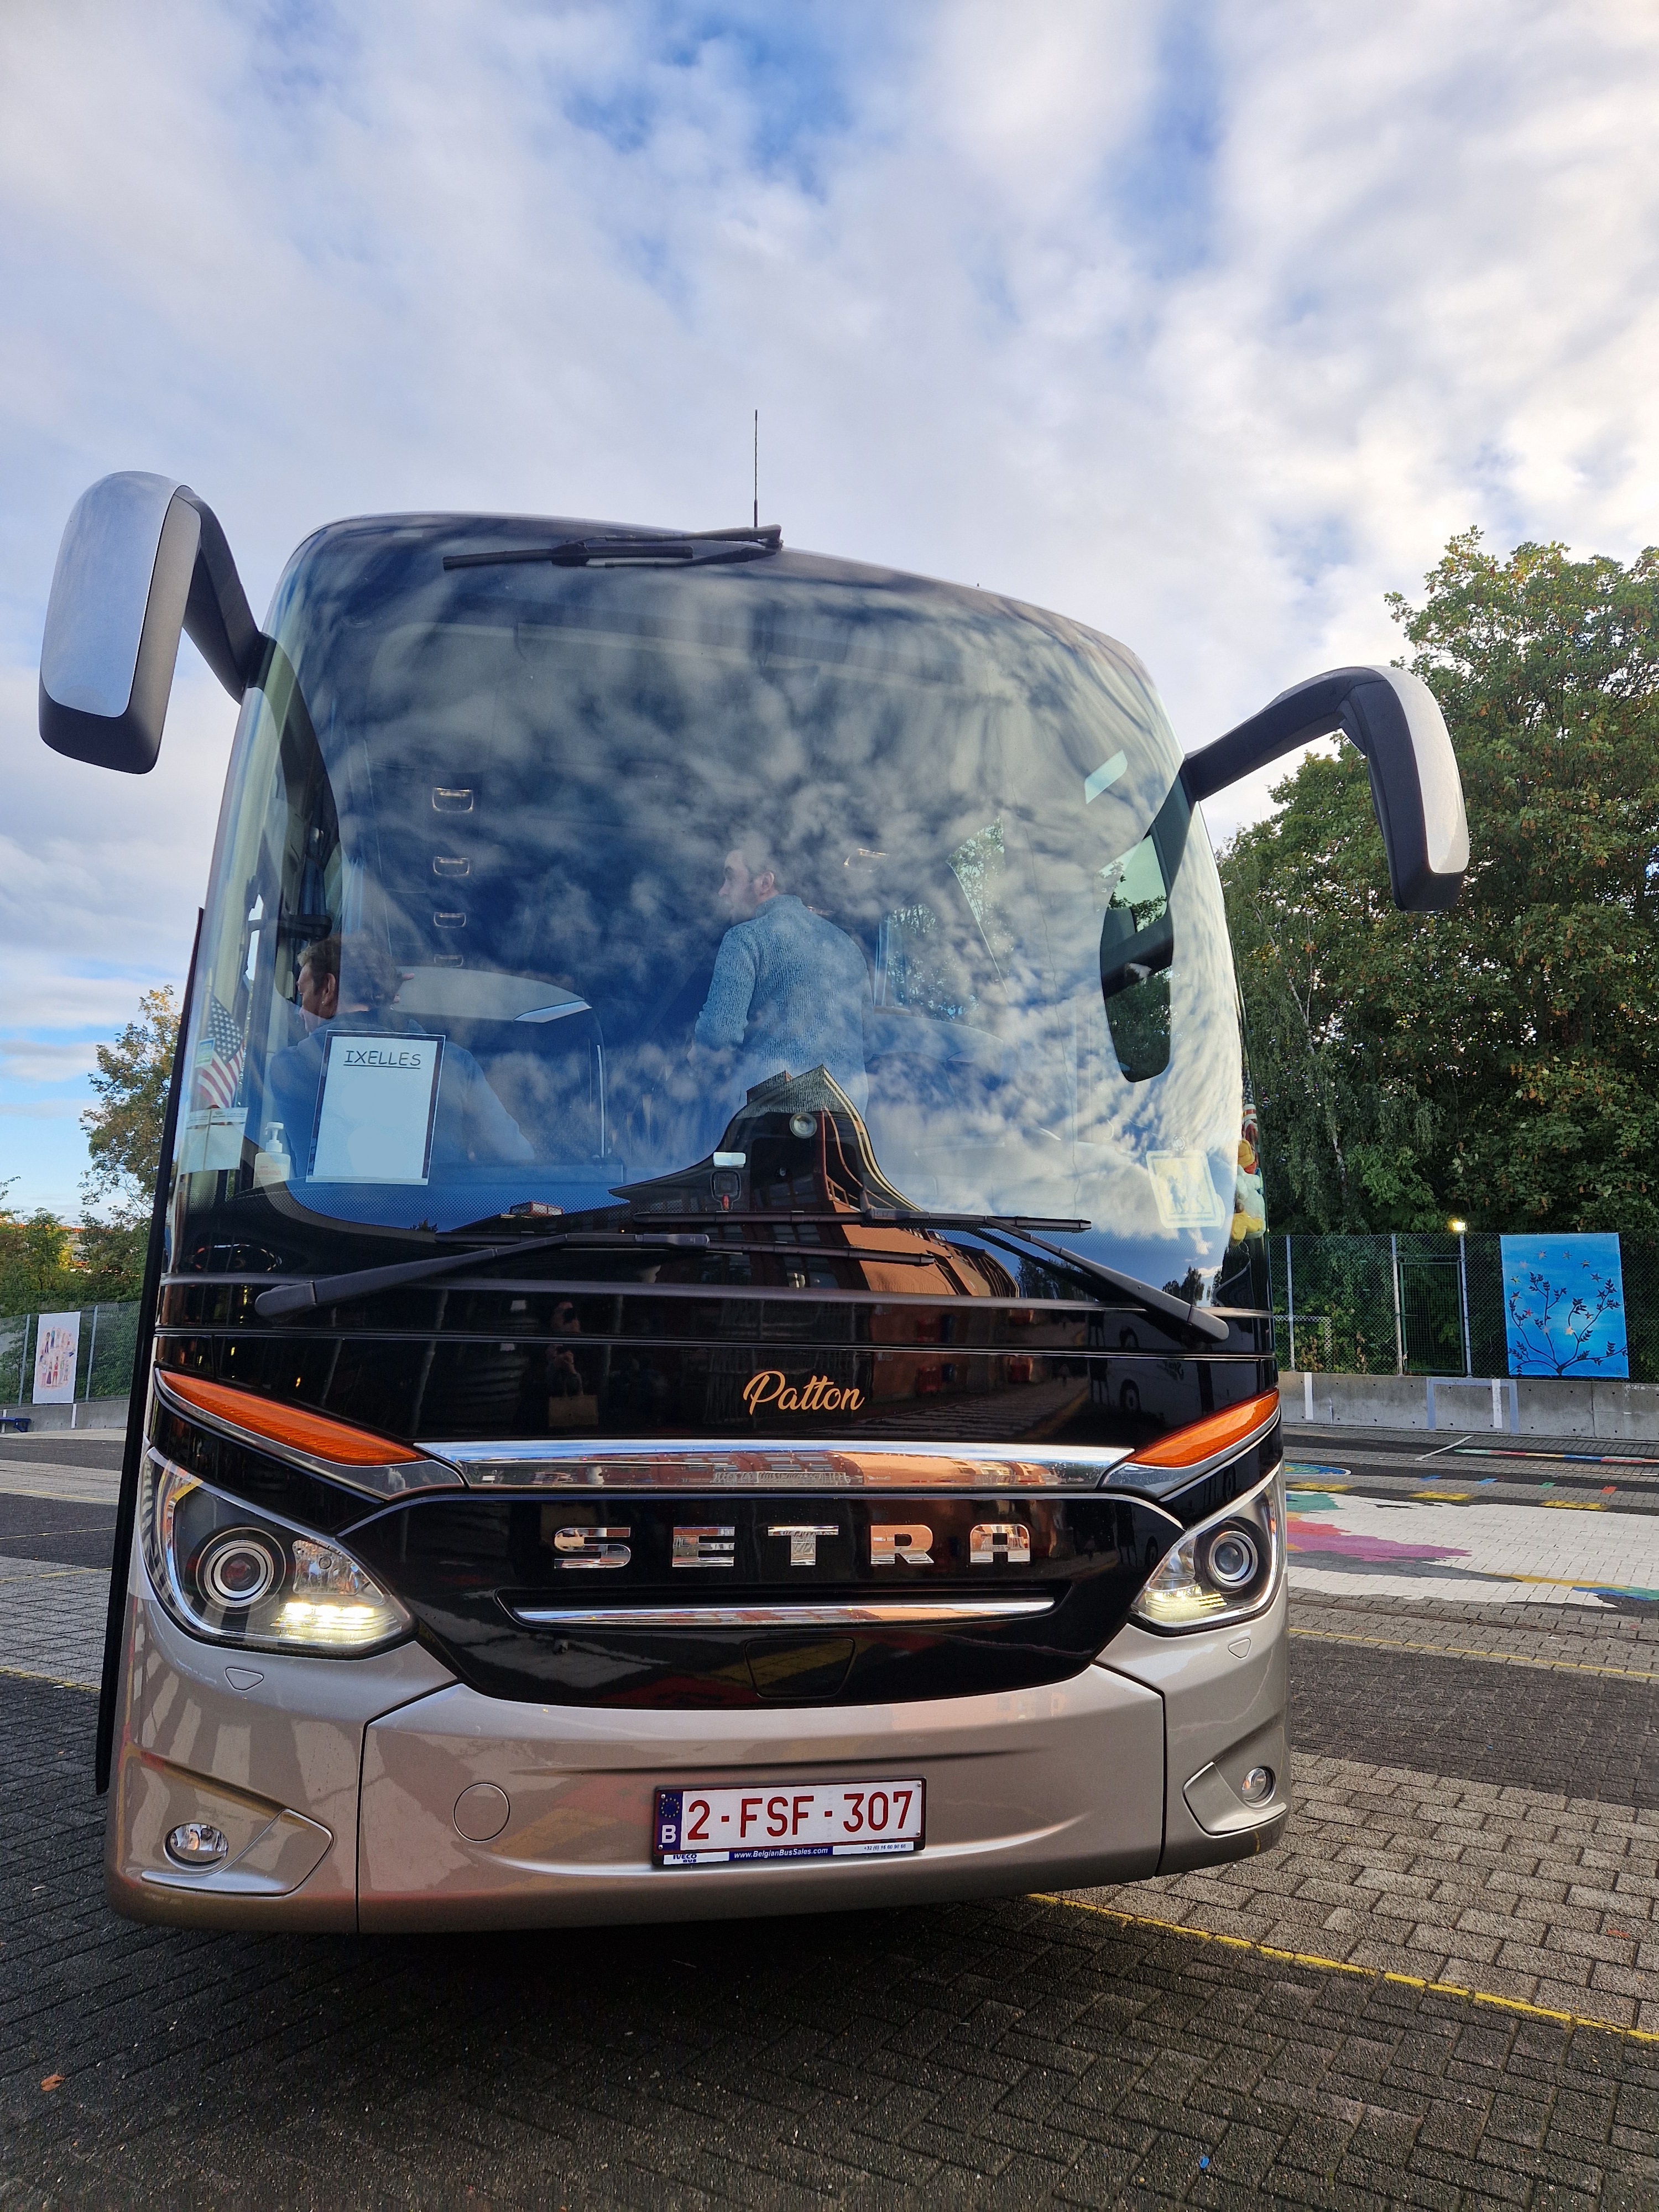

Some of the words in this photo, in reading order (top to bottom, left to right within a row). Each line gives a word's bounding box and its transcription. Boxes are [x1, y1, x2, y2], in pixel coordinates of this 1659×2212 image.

[344, 1050, 421, 1066] IXELLES
[743, 1370, 864, 1416] Patton
[554, 1524, 1030, 1569] SETRA
[661, 1825, 676, 1843] B
[734, 1849, 828, 1858] www.BelgianBusSales.com
